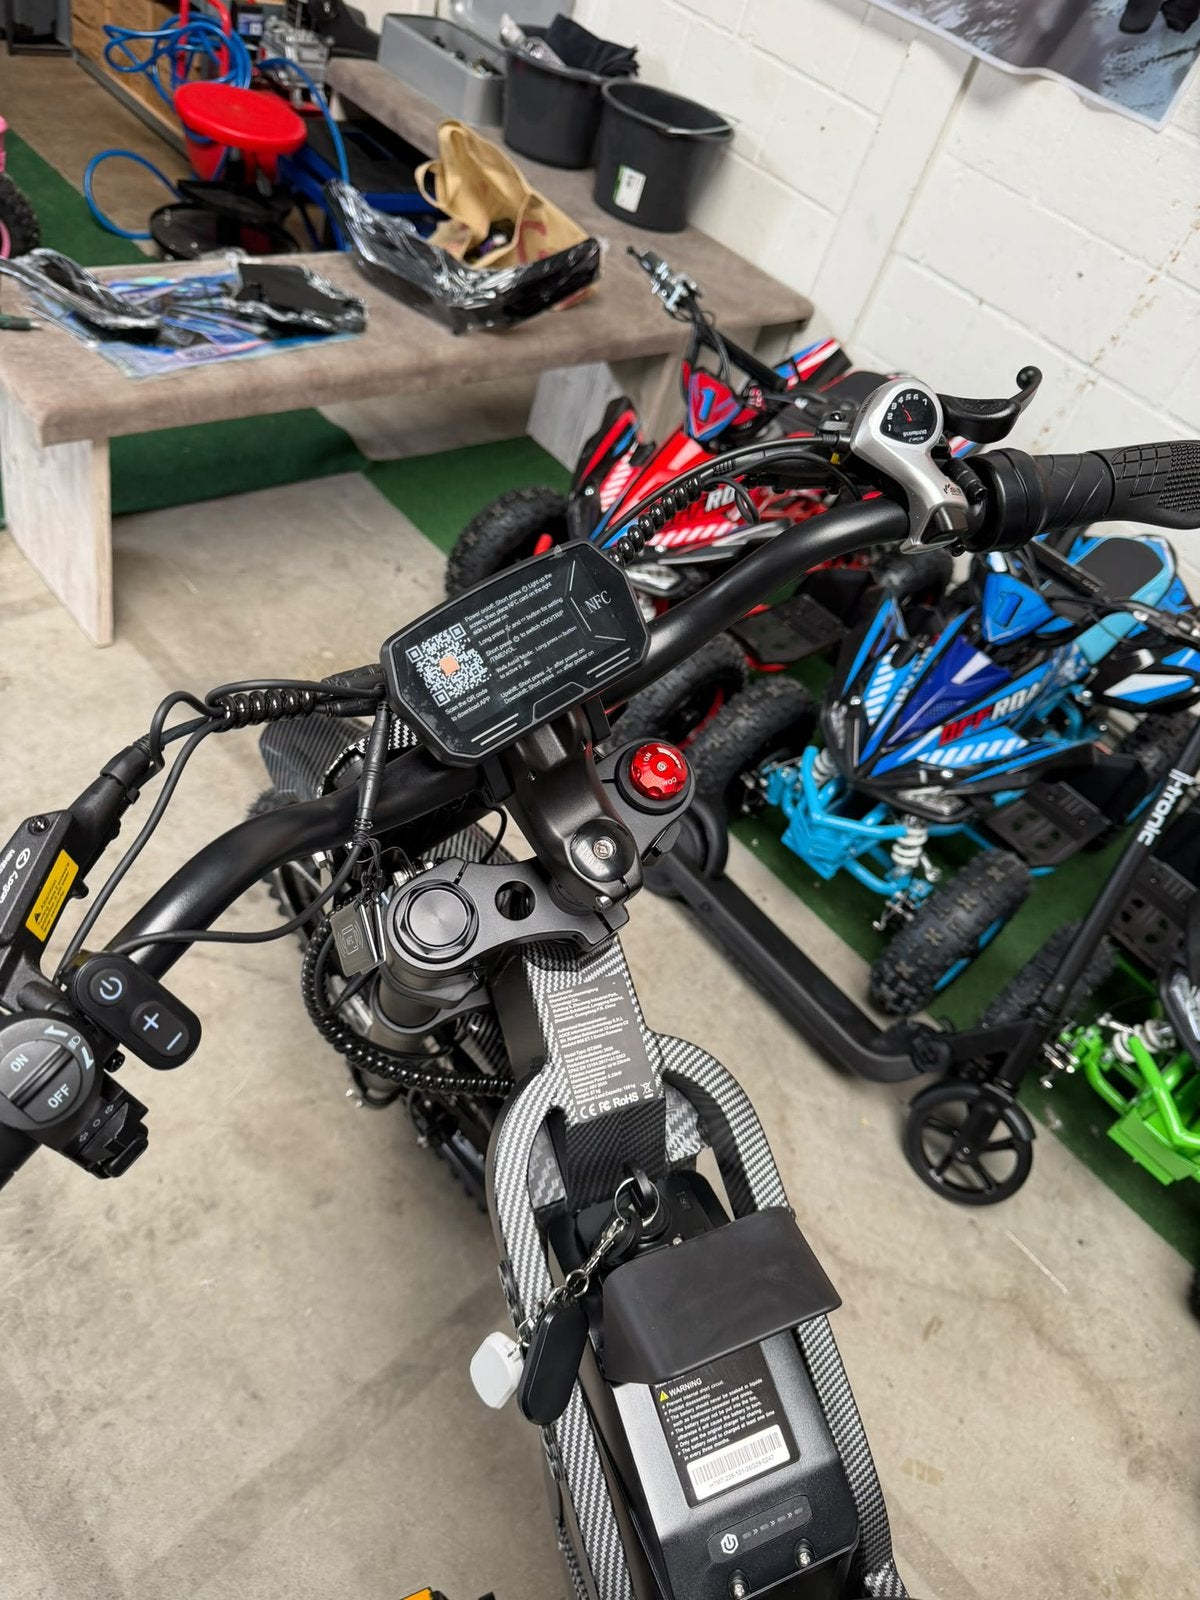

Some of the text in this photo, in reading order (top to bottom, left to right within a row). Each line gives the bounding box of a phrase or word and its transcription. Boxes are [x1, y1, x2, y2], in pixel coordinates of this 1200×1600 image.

[507, 588, 522, 600] press
[584, 589, 613, 613] NFC
[478, 635, 493, 647] Long
[491, 628, 505, 639] press
[510, 619, 521, 628] and
[525, 608, 541, 620] button
[546, 596, 563, 609] setting
[534, 641, 547, 652] Long
[561, 624, 577, 636] button
[517, 677, 532, 688] Short
[530, 670, 546, 682] press
[552, 658, 565, 668] after
[563, 650, 579, 663] power
[527, 679, 541, 690] Short
[540, 672, 555, 683] press
[562, 660, 574, 670] after
[573, 653, 588, 665] power
[444, 687, 488, 715] Scan the QR code
[455, 701, 480, 718] download
[478, 694, 492, 706] APP
[10, 1053, 29, 1072] ON
[48, 1084, 71, 1109] OFF
[612, 1090, 639, 1108] RoHS
[665, 1397, 683, 1408] Prevent
[698, 1385, 710, 1393] short
[668, 1377, 702, 1397] WARNING
[667, 1403, 684, 1414] Prohibit
[670, 1413, 679, 1421] The
[679, 1406, 695, 1418] battery
[694, 1400, 709, 1410] should
[709, 1396, 722, 1404] never
[728, 1385, 744, 1395] soaked
[672, 1419, 683, 1427] such
[675, 1426, 684, 1434] The
[683, 1420, 699, 1431] battery
[699, 1415, 710, 1423] must
[724, 1405, 733, 1413] put
[676, 1428, 697, 1441] otherwise
[701, 1422, 710, 1430] will
[709, 1417, 723, 1426] cause
[730, 1407, 746, 1418] battery
[678, 1439, 690, 1448] Only
[706, 1425, 723, 1436] original
[722, 1418, 740, 1429] charger
[681, 1446, 690, 1454] The
[690, 1440, 706, 1451] battery
[705, 1435, 718, 1443] need
[722, 1425, 741, 1436] charged
[745, 1417, 756, 1426] least
[688, 1450, 702, 1459] every
